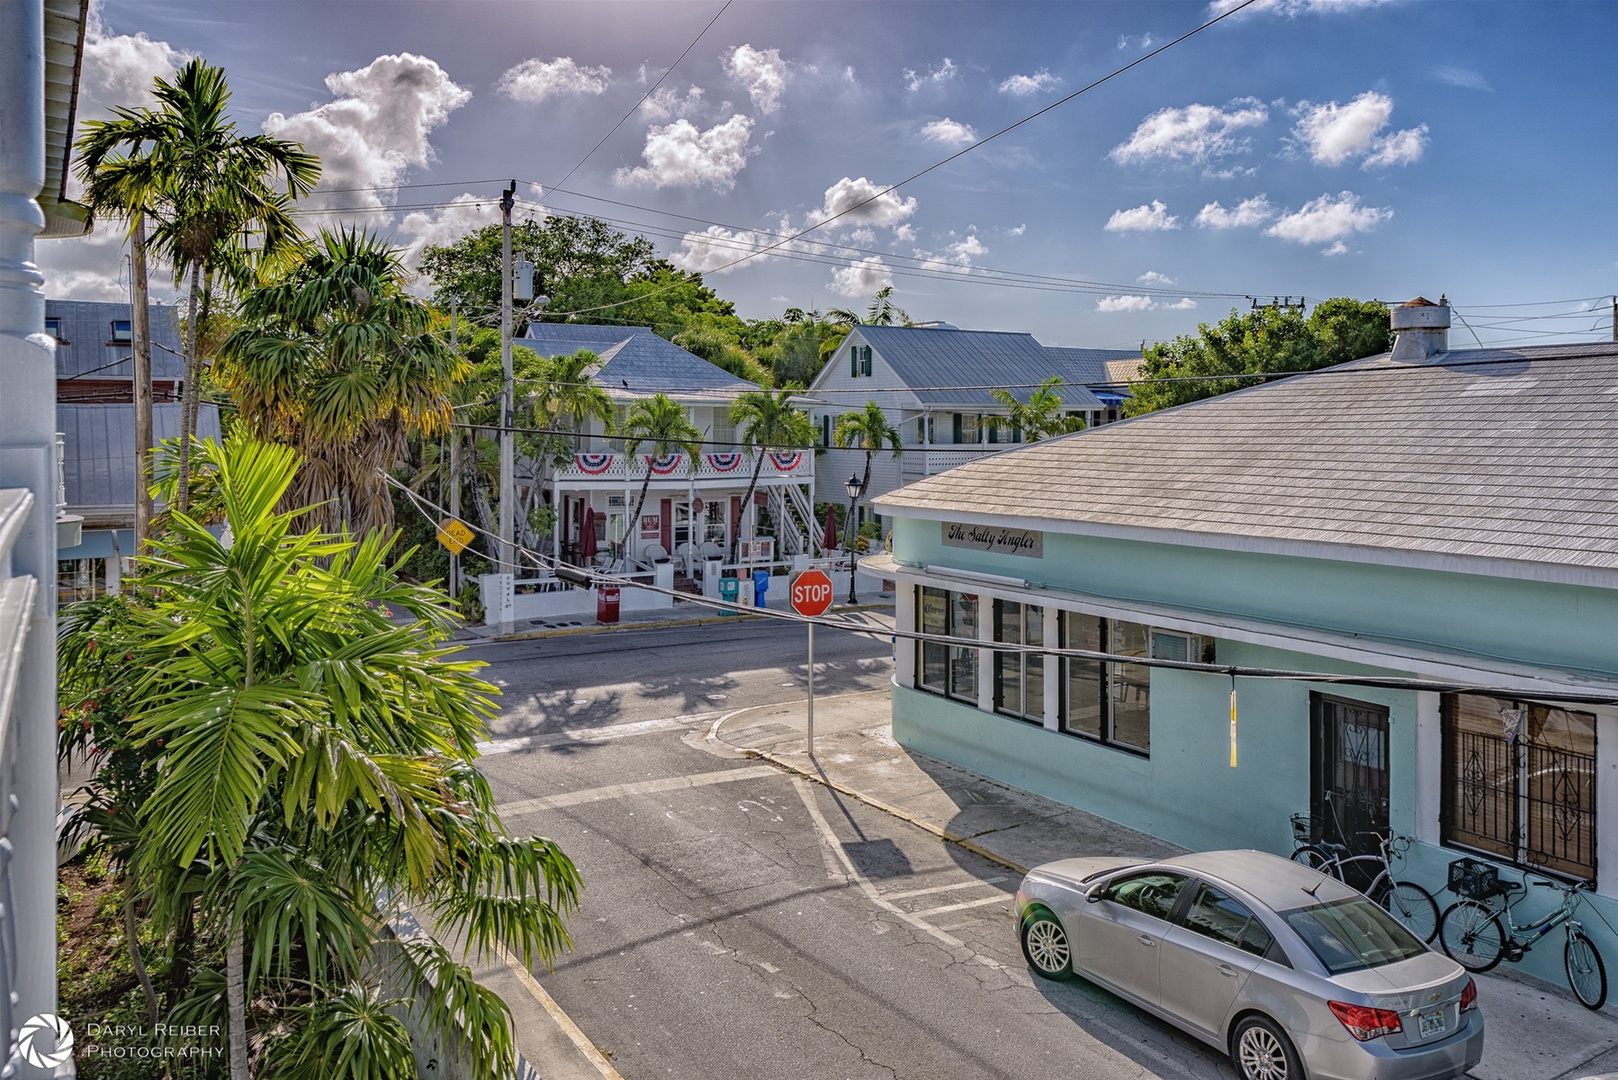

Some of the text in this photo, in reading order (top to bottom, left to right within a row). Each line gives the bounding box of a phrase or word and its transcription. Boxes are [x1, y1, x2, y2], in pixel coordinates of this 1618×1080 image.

[948, 524, 1034, 553] The Salty Angler
[795, 584, 830, 603] STOP
